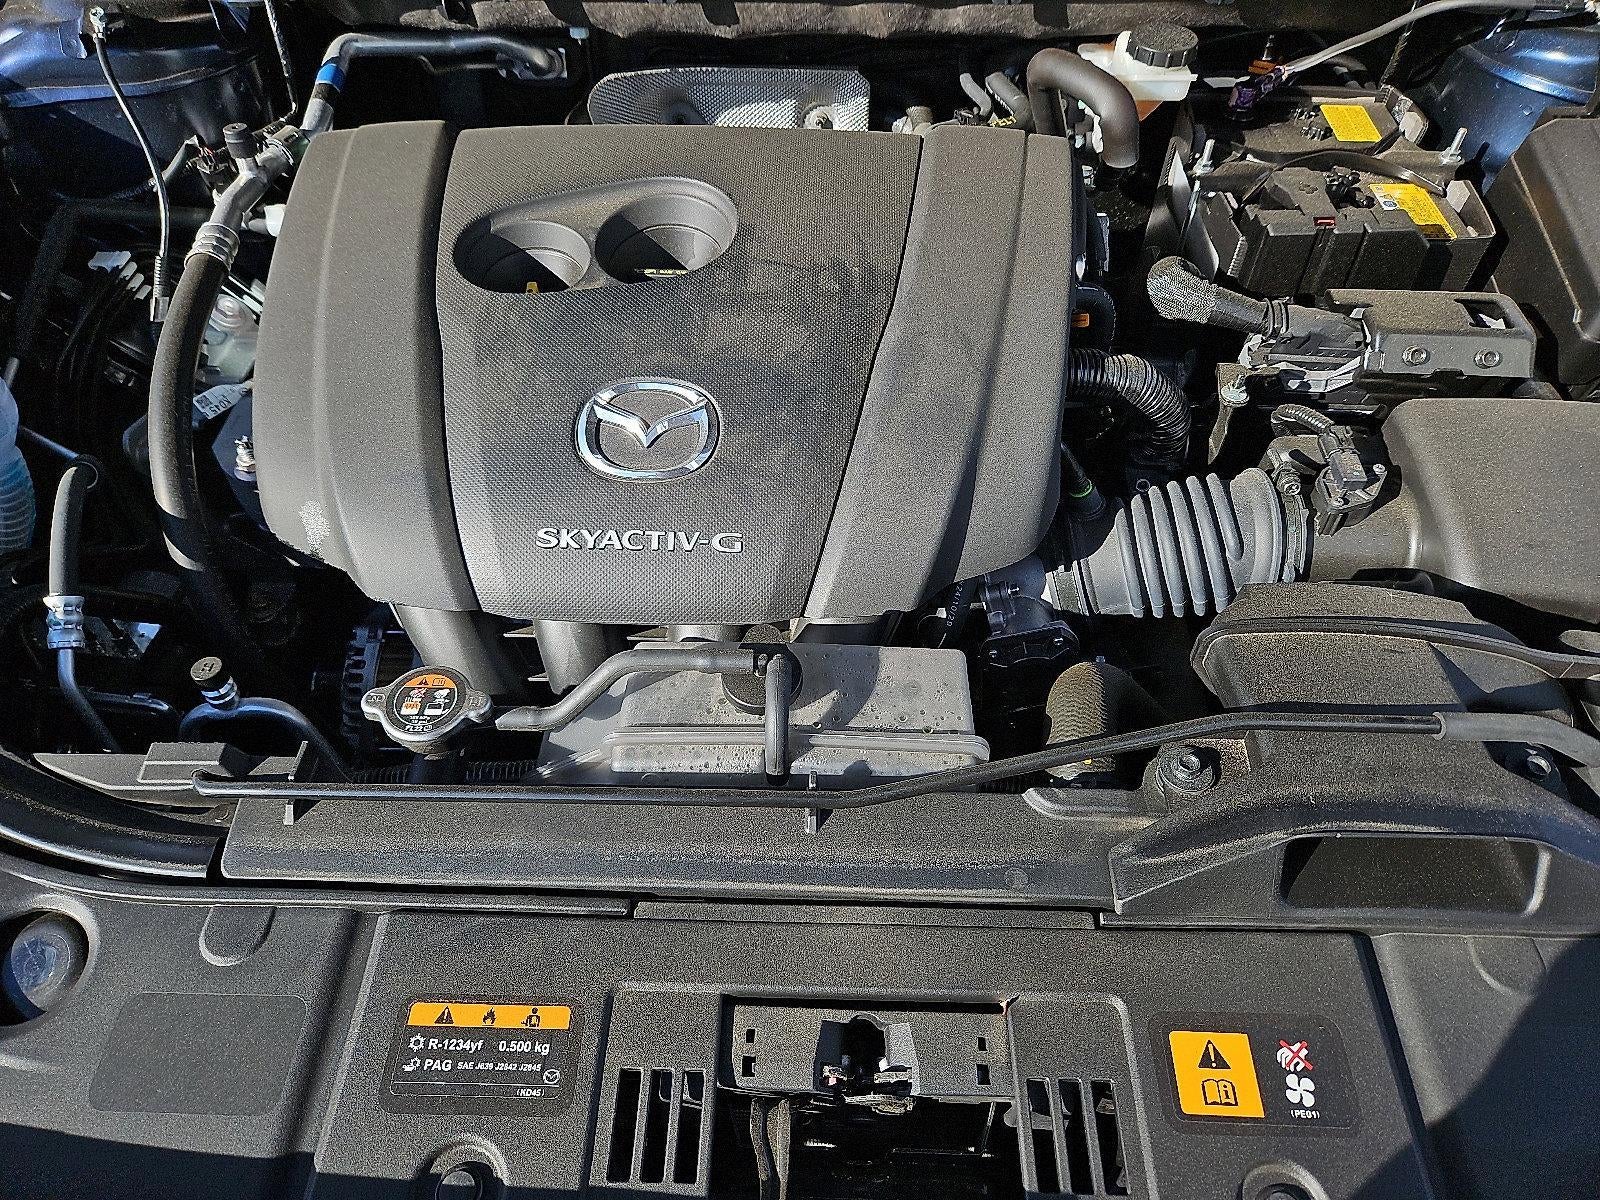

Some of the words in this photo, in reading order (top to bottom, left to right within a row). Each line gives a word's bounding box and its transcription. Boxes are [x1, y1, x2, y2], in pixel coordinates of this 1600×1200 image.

[535, 527, 744, 554] SKYACTIV-G
[427, 1038, 484, 1054] R-1234yf
[498, 1040, 531, 1053] 0.500
[534, 1040, 550, 1056] kg
[423, 1059, 453, 1071] PAG
[456, 1061, 474, 1070] SAE
[1290, 1109, 1320, 1119] (PE01)
